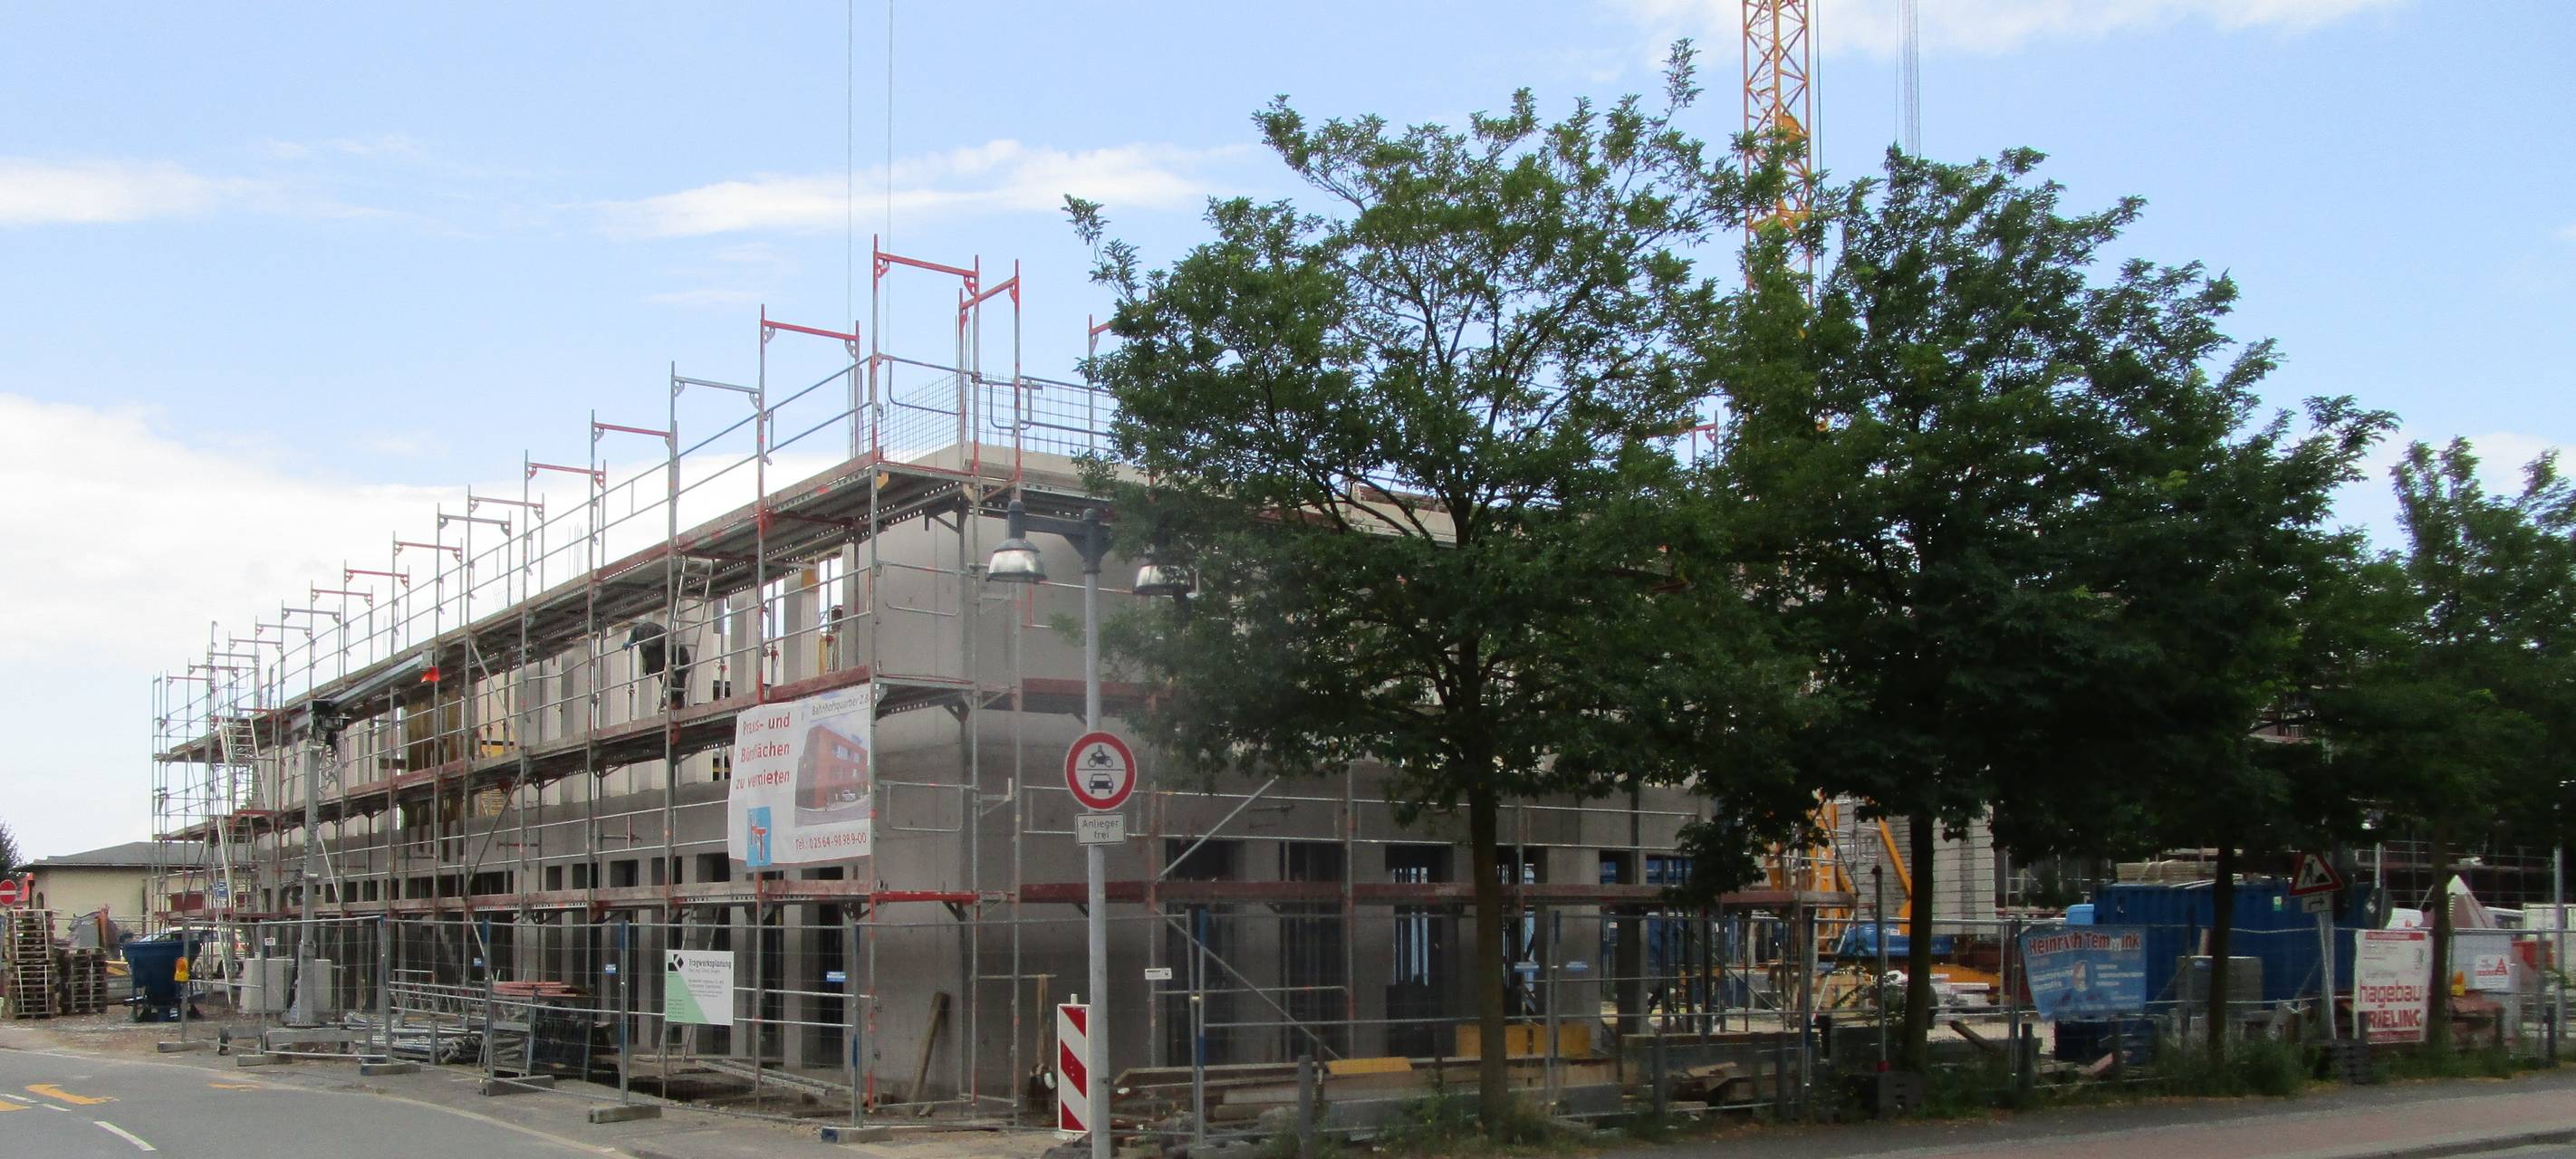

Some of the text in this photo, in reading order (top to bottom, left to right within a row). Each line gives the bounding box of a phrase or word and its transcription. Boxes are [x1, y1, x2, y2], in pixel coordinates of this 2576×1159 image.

[768, 712, 790, 730] und
[735, 778, 745, 790] zu
[1082, 819, 1119, 829] Anlieger
[1094, 830, 1110, 839] frei
[688, 958, 732, 970] Tragwerksplanung
[2359, 978, 2422, 1008] hagebau
[2367, 1009, 2421, 1029] RIELING
